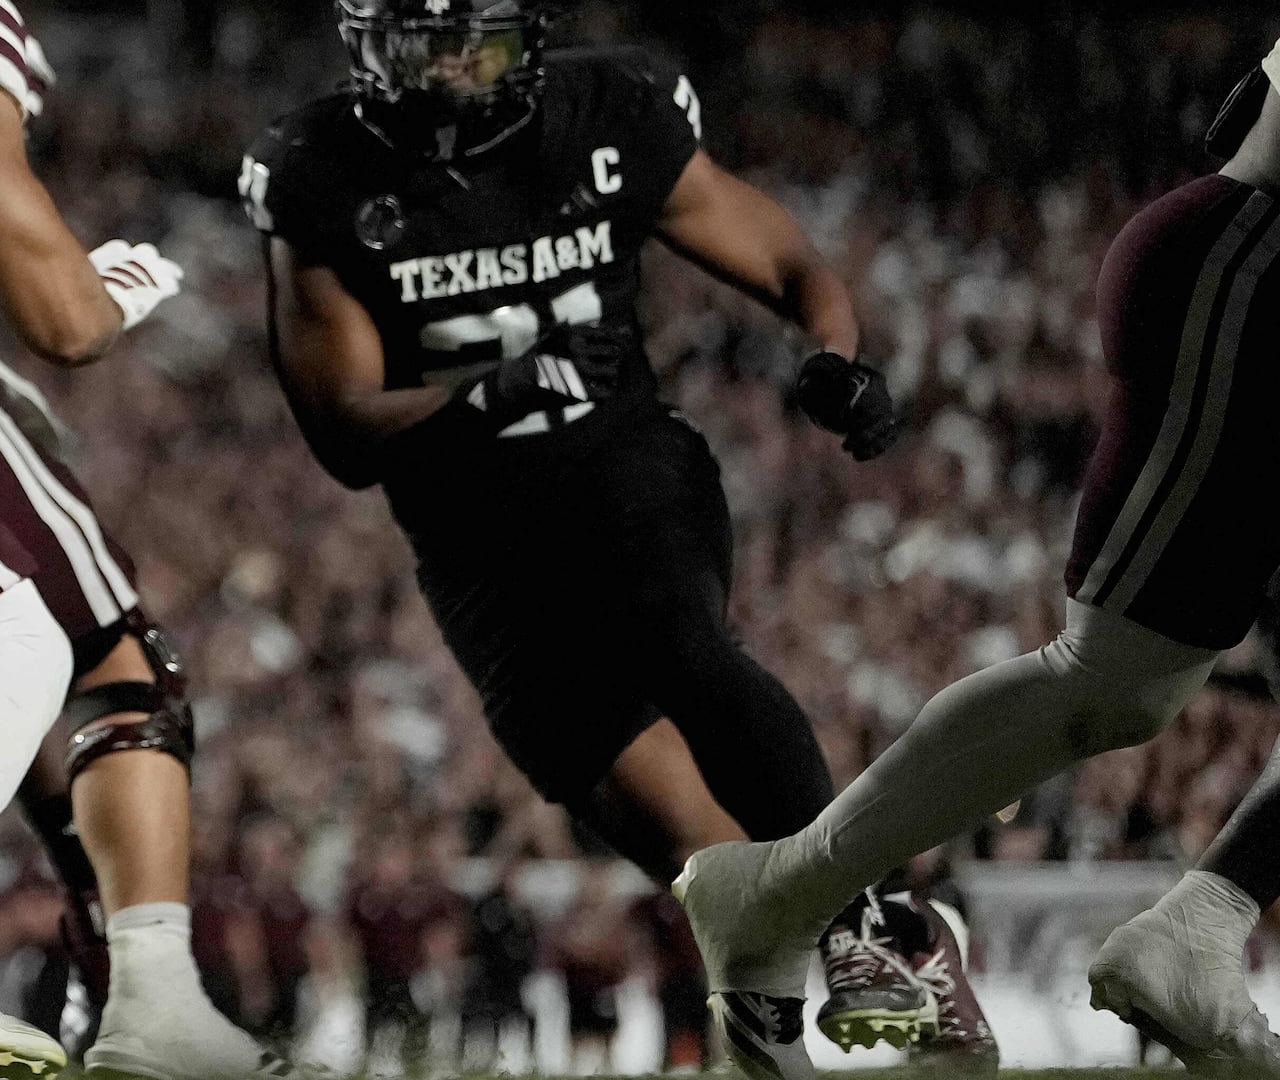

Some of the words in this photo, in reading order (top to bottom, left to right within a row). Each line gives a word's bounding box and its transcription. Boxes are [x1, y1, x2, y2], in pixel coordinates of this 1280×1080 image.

[591, 146, 622, 194] C
[390, 242, 528, 303] TEXAS
[531, 220, 615, 283] A&M
